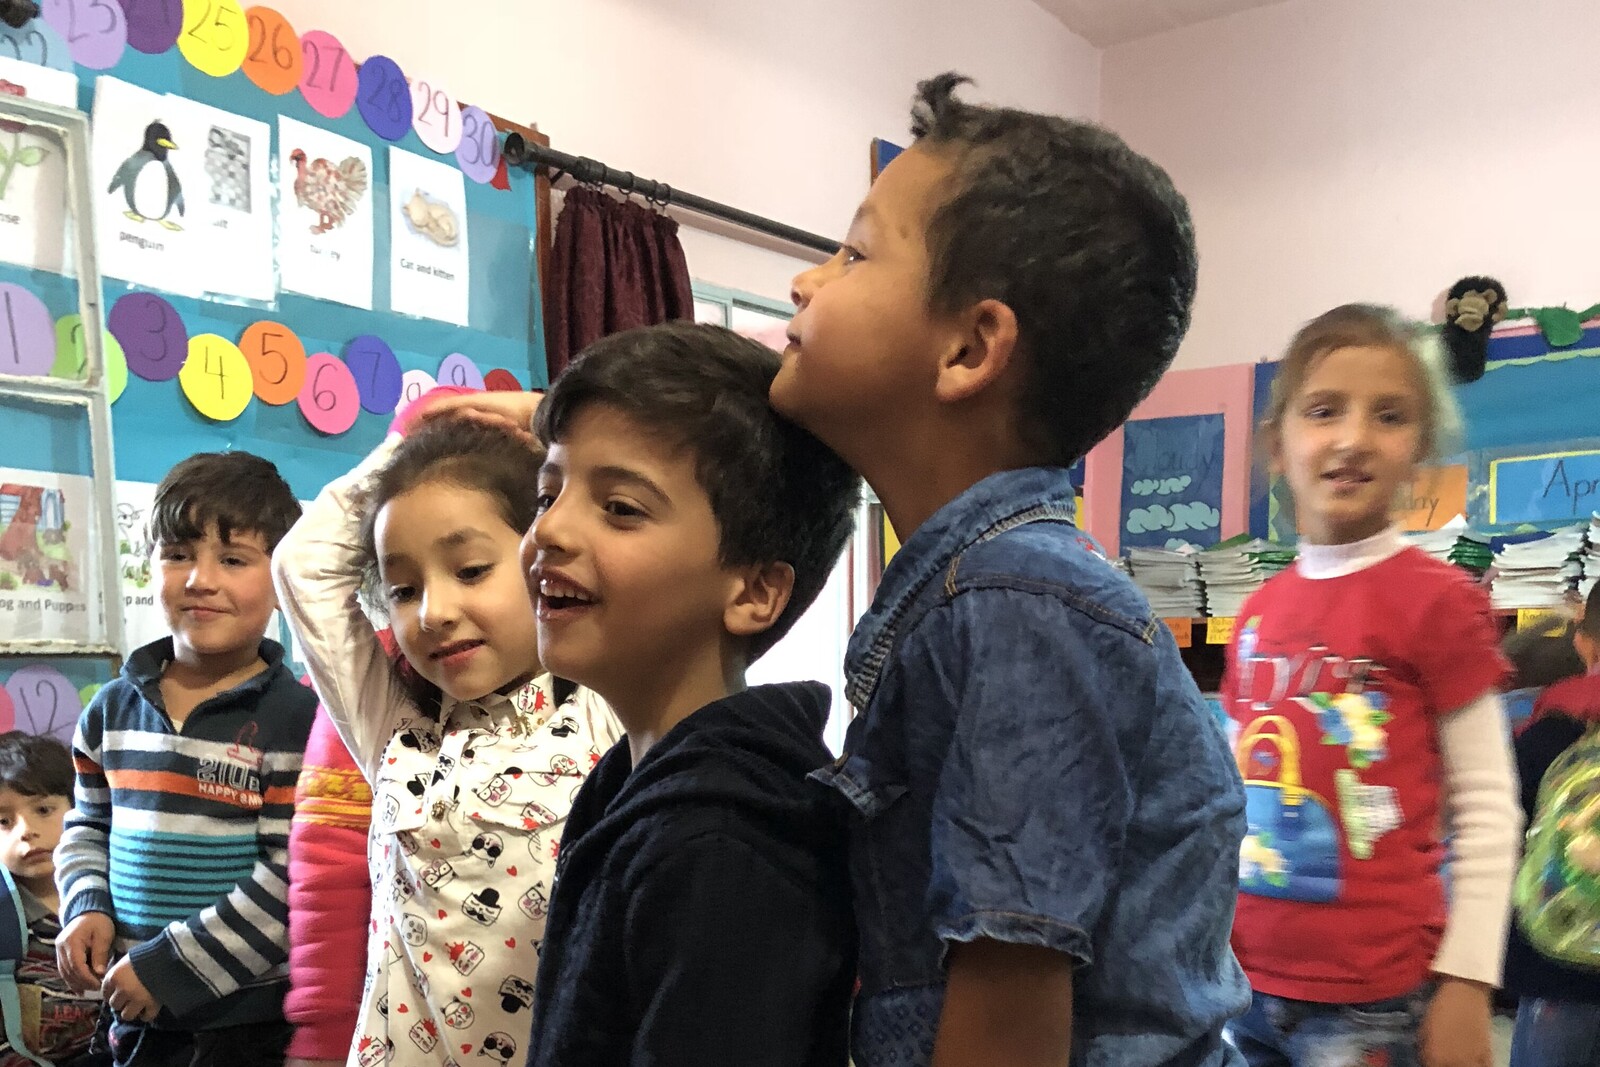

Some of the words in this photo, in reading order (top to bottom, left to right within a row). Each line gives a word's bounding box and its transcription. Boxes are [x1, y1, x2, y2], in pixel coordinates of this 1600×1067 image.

[188, 0, 238, 52] 25
[248, 14, 294, 70] 26
[302, 39, 347, 92] 27
[367, 64, 403, 123] 28
[417, 81, 450, 138] 29
[462, 113, 497, 167] 30
[416, 264, 431, 274] and
[140, 300, 168, 362] 3
[204, 346, 229, 400] 4
[258, 332, 289, 385] 5
[359, 351, 382, 399] 7
[312, 362, 338, 412] 6
[18, 598, 41, 609] and
[135, 594, 154, 605] and
[198, 782, 239, 801] HAPPY
